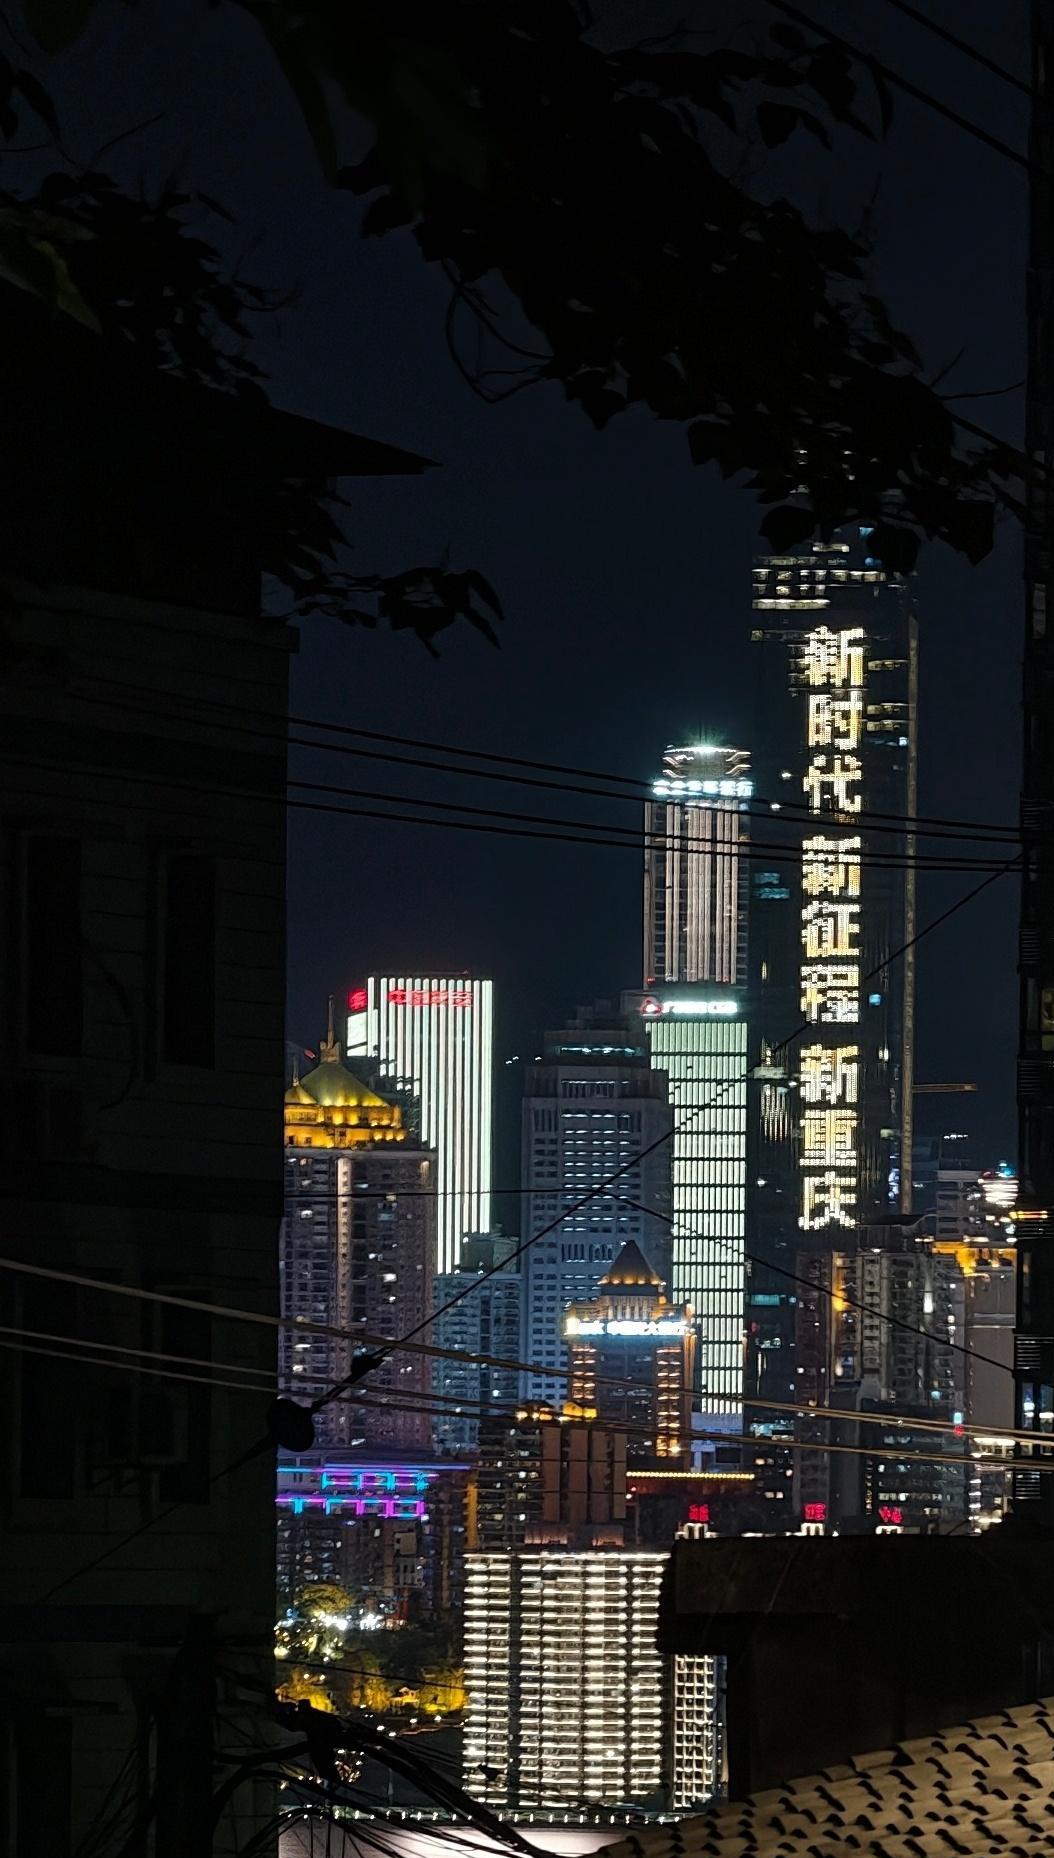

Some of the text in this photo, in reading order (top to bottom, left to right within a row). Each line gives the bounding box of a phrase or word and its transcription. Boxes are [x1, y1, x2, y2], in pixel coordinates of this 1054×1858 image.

[798, 626, 864, 1230] 新时代 新征程 新重庆
